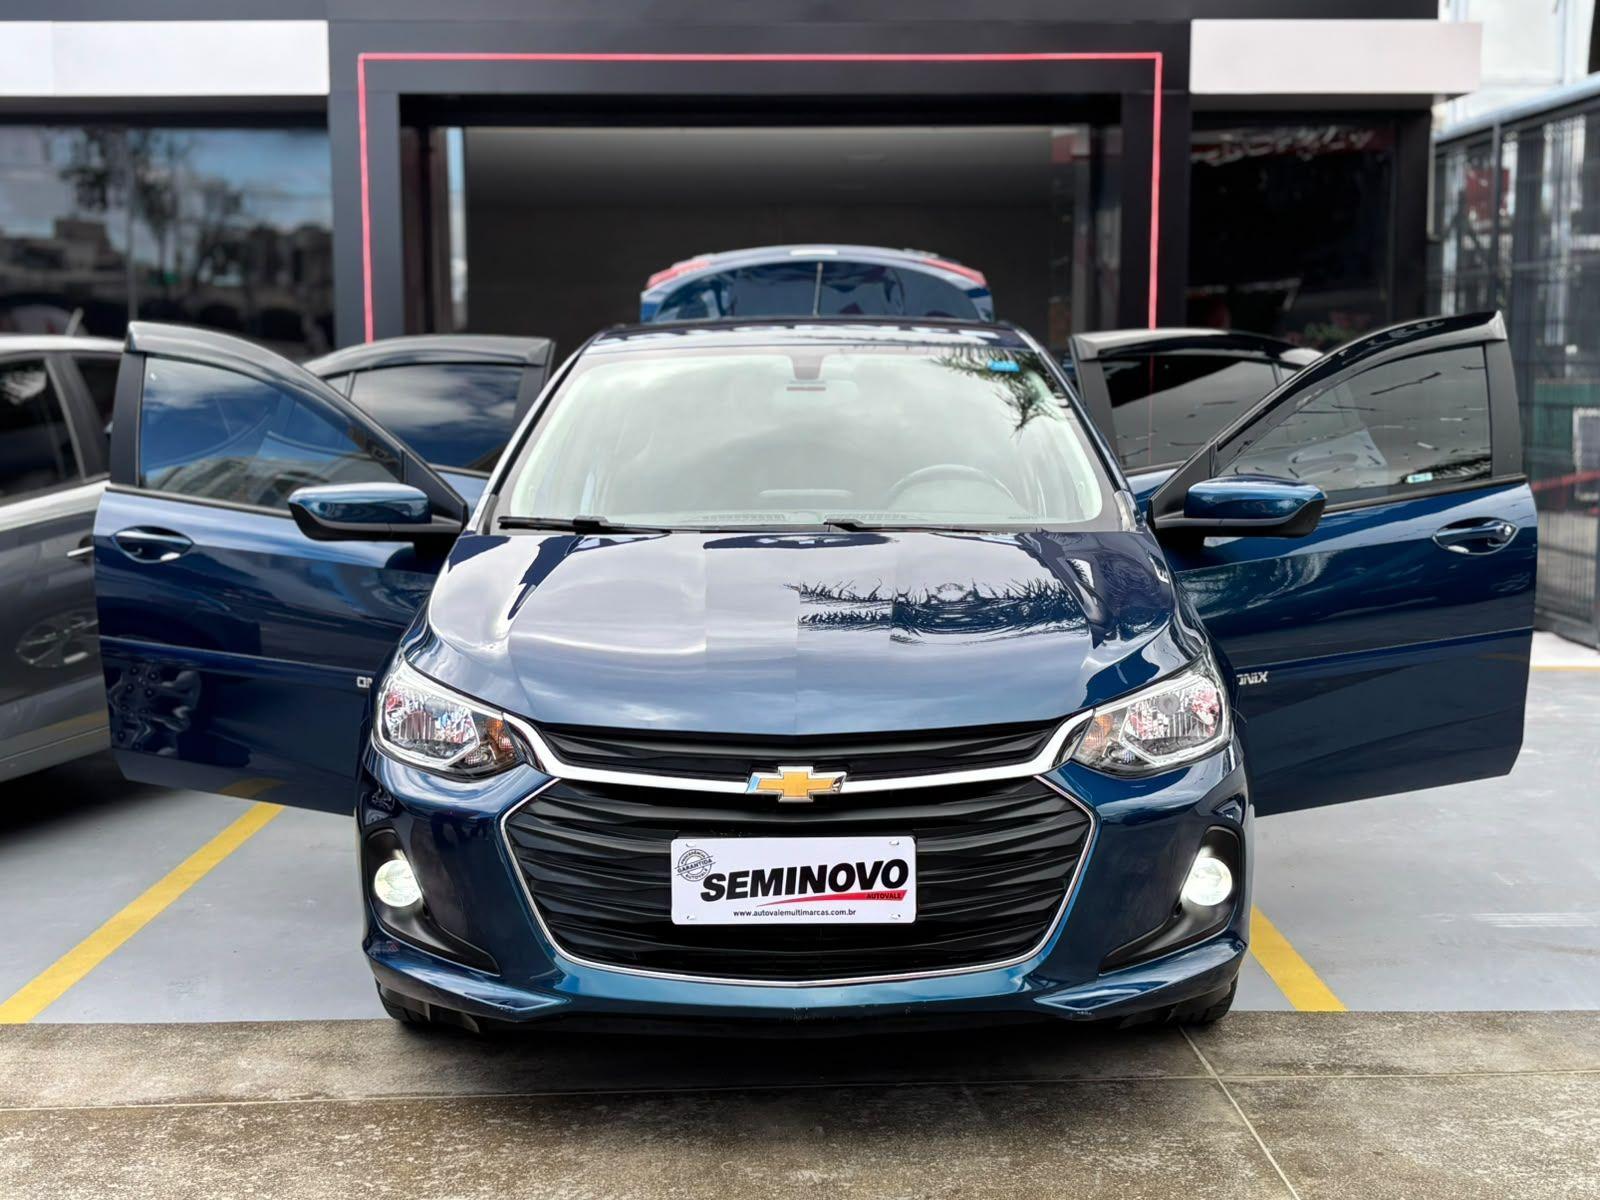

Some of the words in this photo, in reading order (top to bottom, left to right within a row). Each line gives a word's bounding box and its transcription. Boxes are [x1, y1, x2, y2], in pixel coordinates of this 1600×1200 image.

[677, 858, 712, 873] GARANTIDA
[700, 859, 909, 902] SEMINOVO
[866, 892, 901, 900] AUTOVALE
[733, 908, 856, 917] www.autovalemultimarcas.com.br
